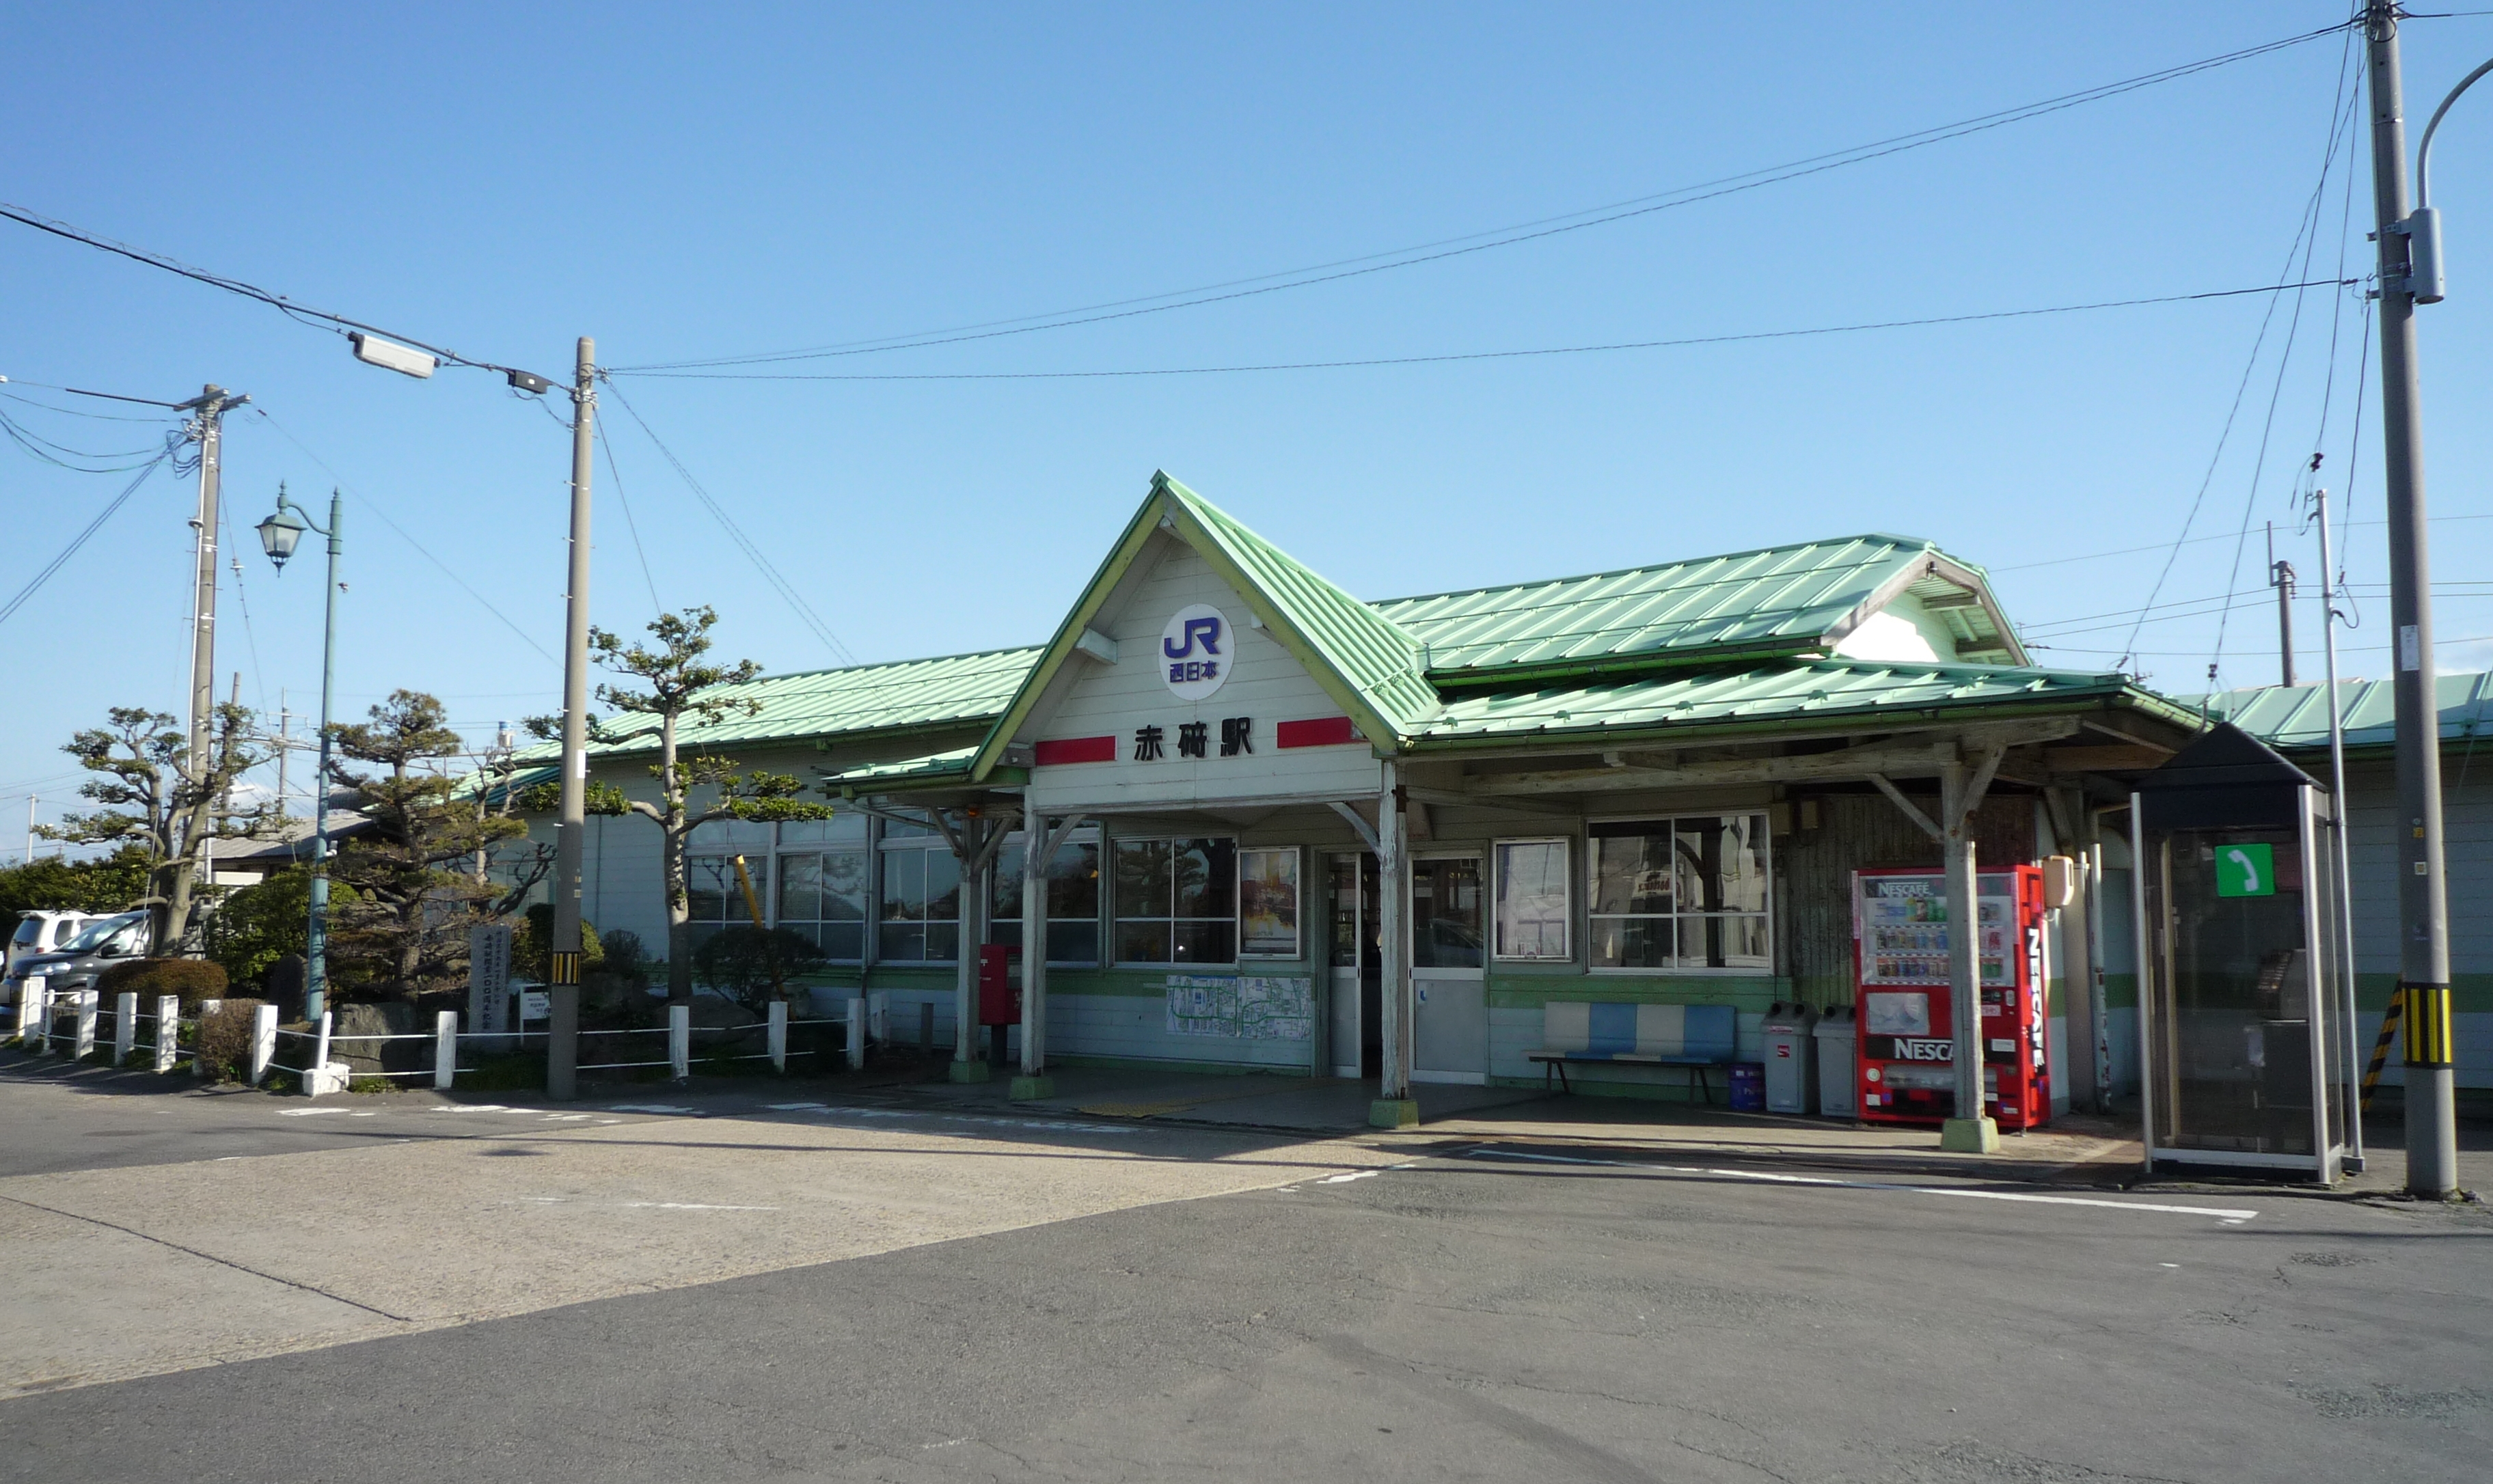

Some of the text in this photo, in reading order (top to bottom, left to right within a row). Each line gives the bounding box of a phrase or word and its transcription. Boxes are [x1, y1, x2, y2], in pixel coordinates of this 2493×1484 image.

[1164, 617, 1221, 659] JR
[1169, 660, 1218, 683] 西日本
[1894, 1038, 1953, 1060] NESC
